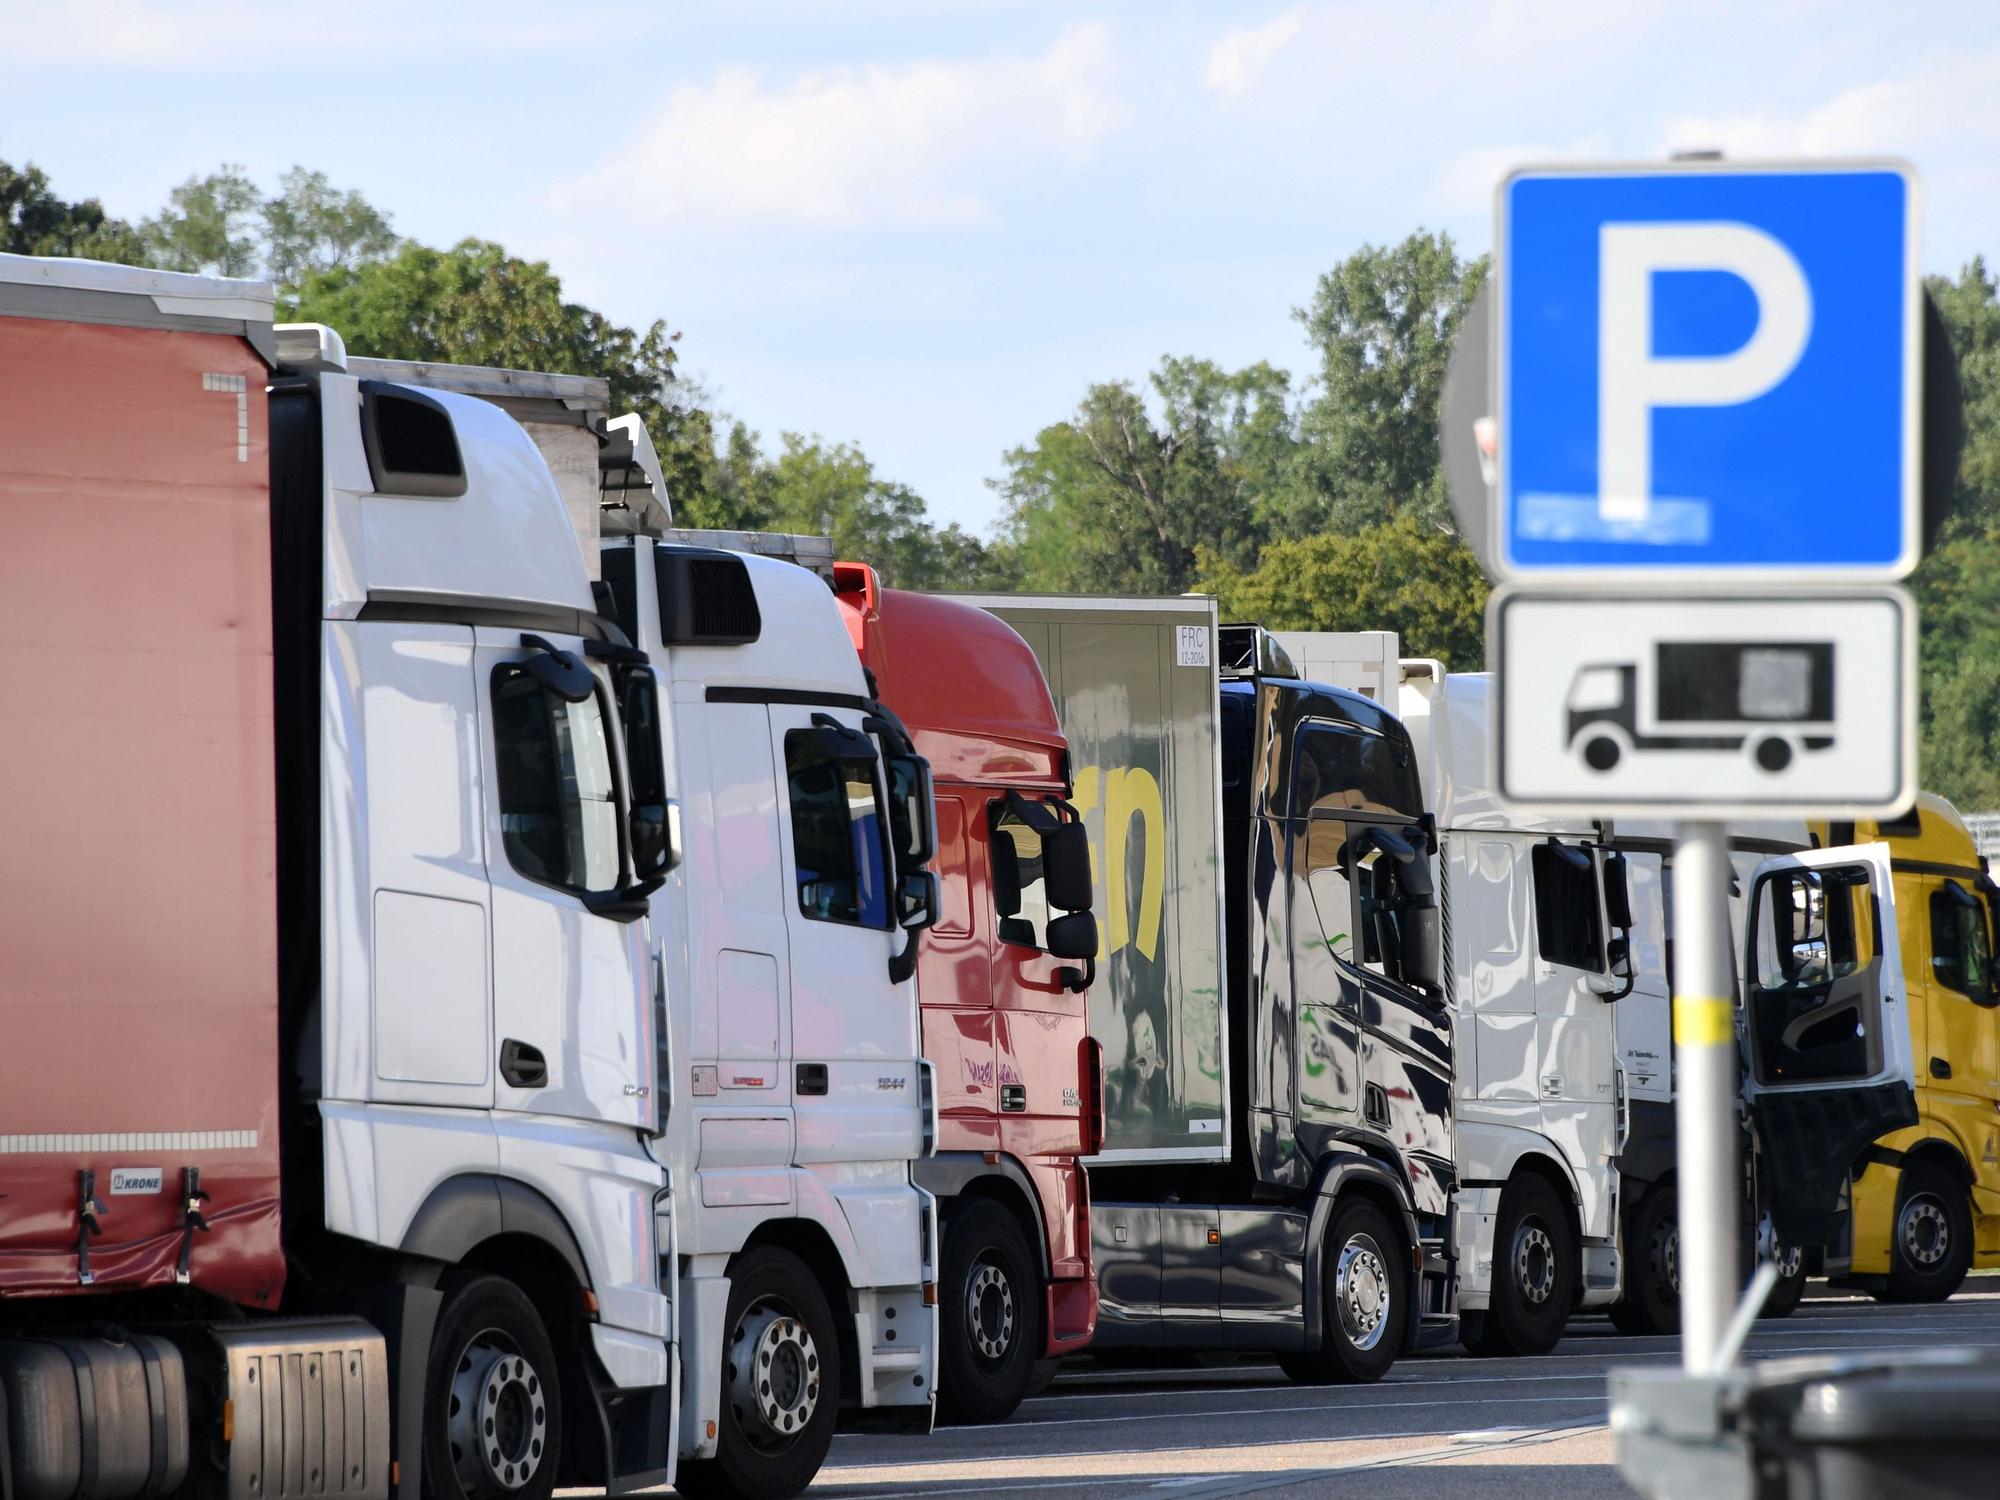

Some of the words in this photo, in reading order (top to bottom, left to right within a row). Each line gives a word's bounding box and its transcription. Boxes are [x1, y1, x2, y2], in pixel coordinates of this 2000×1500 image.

[1598, 221, 1814, 521] P
[1181, 627, 1203, 648] FRC
[1181, 651, 1205, 664] 12-2016
[124, 1177, 160, 1189] KRONE
